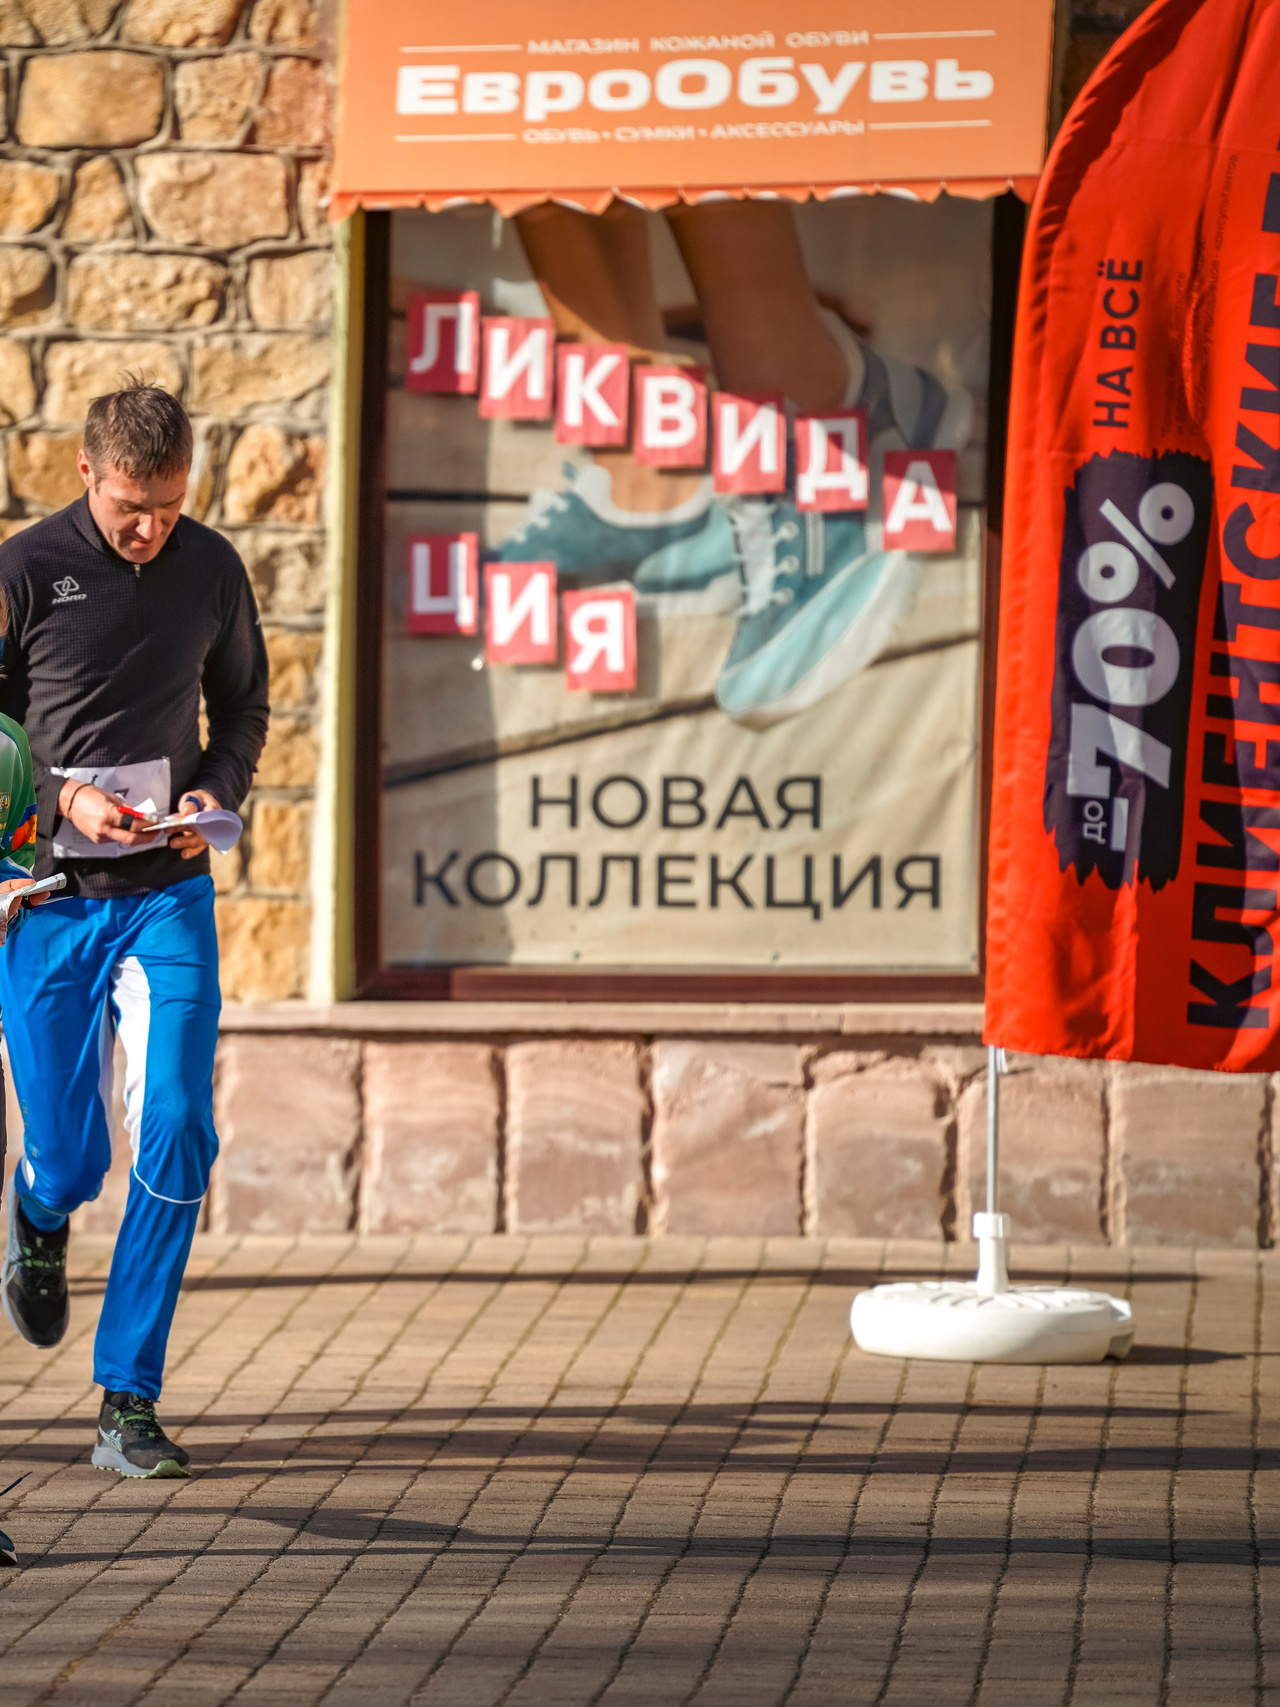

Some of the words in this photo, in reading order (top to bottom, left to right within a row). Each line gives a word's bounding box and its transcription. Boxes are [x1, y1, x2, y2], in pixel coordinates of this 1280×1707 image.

[527, 37, 640, 55] МАГАЗИН
[650, 31, 775, 51] КОЖАНОЙ
[785, 30, 870, 48] ОБУВИ
[395, 56, 995, 122] ЕвроОбувь
[522, 128, 600, 144] ОБУВЬ
[614, 125, 695, 142] СУМКИ
[710, 120, 866, 139] АКСЕССУАРЫ
[1096, 259, 1143, 350] ВСЁ
[410, 300, 954, 533] ЛИКВИДА
[1093, 365, 1133, 428] НА
[412, 542, 625, 674] ЦИЯ
[529, 774, 823, 830] НОВАЯ
[413, 850, 942, 922] КОЛЛЕКЦИЯ
